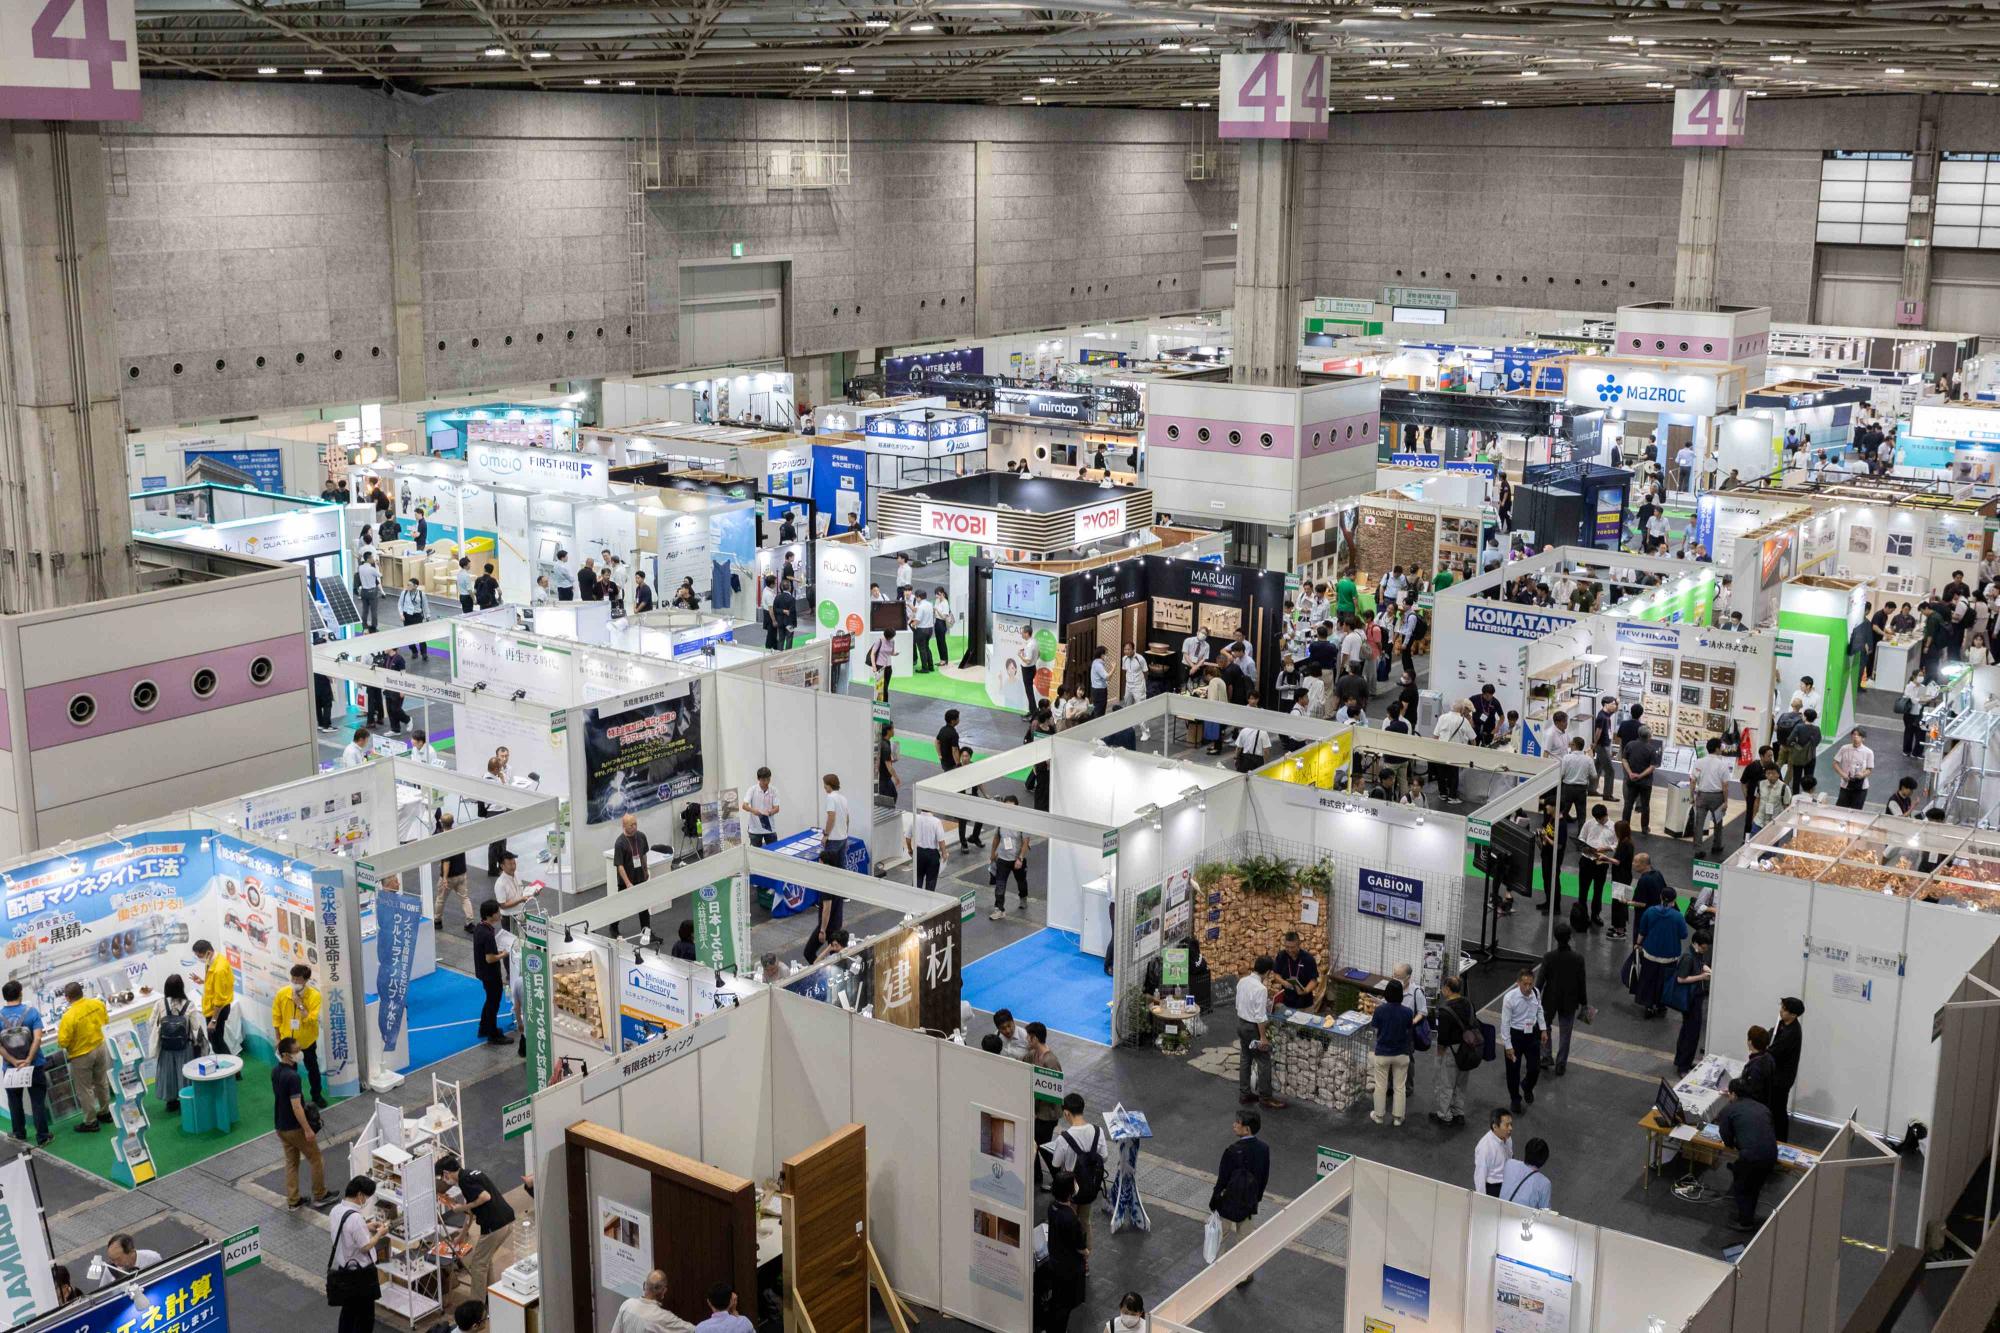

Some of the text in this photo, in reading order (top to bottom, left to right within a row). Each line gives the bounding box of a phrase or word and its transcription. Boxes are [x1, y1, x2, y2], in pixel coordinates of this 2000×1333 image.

[31, 0, 127, 90] 4
[1237, 53, 1285, 124] 4
[1302, 56, 1326, 123] 4
[1687, 90, 1724, 135] 4
[1731, 91, 1744, 134] 4
[1039, 401, 1078, 416] miratap
[956, 441, 970, 450] AQUA
[529, 455, 579, 473] FIRSTPRO
[932, 511, 986, 536] RYOBI
[1082, 507, 1119, 529] RYOBI
[823, 560, 857, 575] RUCAD
[1191, 570, 1235, 587] MARUKI
[1467, 621, 1515, 636] INTERIOR
[1641, 632, 1677, 643] HIKARI
[1469, 826, 1490, 837] AC026
[1367, 875, 1413, 894] GABION
[1694, 870, 1719, 881] AC025
[6, 857, 182, 920] 配管マグネタイト工法
[110, 882, 177, 911] ではなく水に
[50, 922, 93, 945] 黒錆へ
[528, 924, 547, 937] AC019
[320, 886, 349, 1076] 給水管を延命する 水処理技術!
[645, 972, 677, 991] Miniature
[645, 981, 671, 999] Factory
[622, 1034, 695, 1078] 有限会社シティング
[1034, 1077, 1063, 1093] AC018
[505, 1109, 531, 1128] AC018
[225, 1240, 260, 1262] AC015
[107, 1272, 213, 1333] エネ計算
